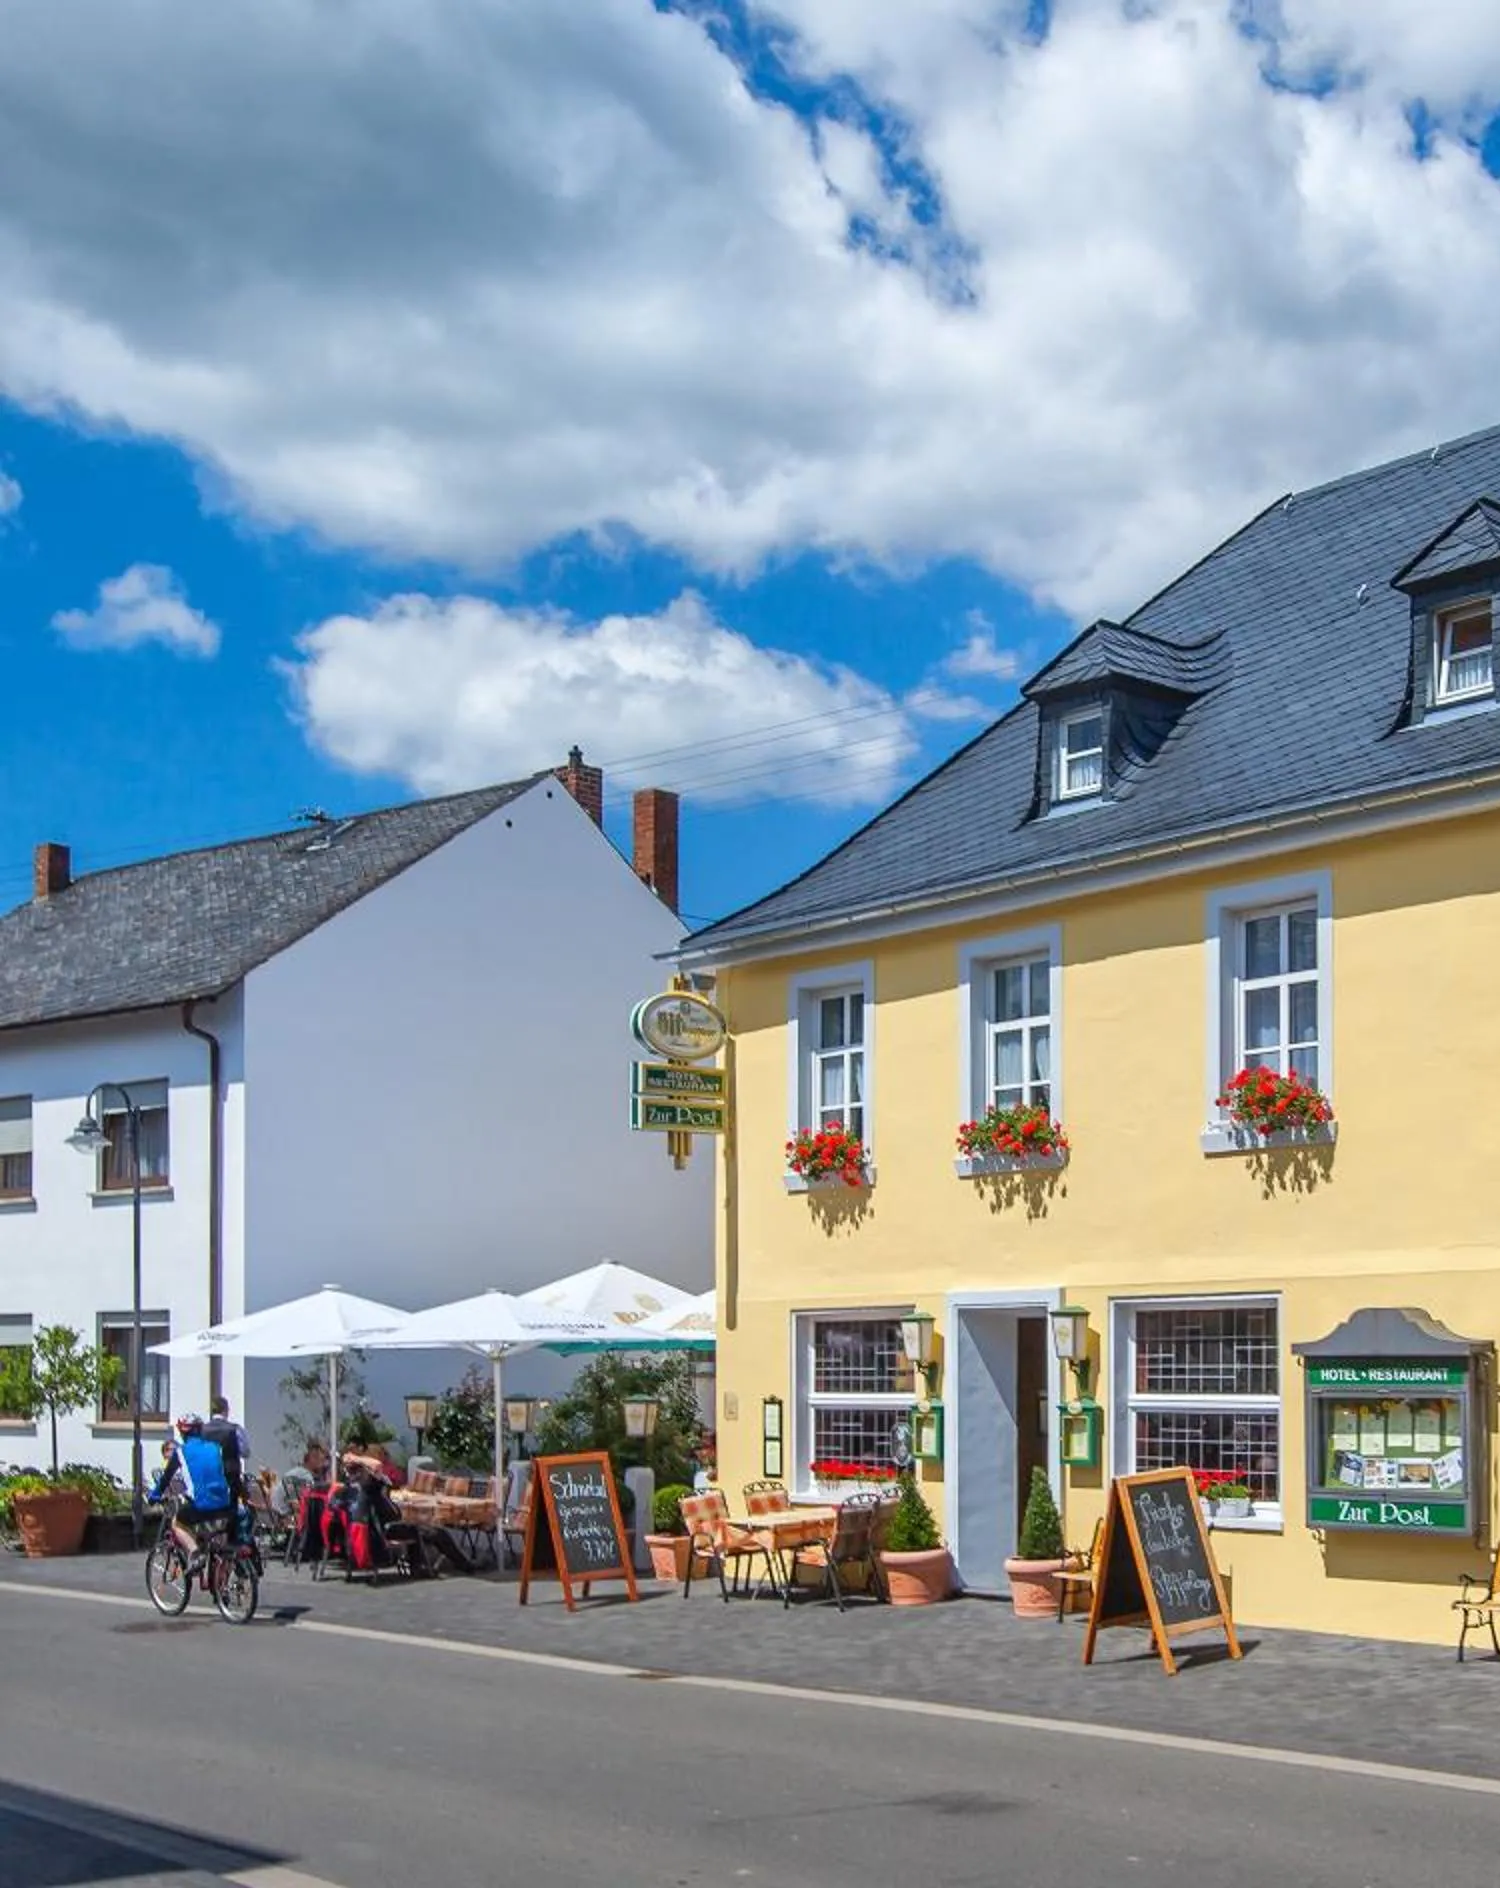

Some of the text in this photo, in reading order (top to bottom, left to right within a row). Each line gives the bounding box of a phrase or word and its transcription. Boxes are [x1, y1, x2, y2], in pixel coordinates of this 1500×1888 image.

[649, 1077, 720, 1091] RESTAURANT
[666, 1070, 703, 1083] HOTEL
[649, 1107, 718, 1126] Zur Post
[1320, 1367, 1450, 1382] HOTEL RESTAURANT
[1338, 1500, 1435, 1526] Zur Post
